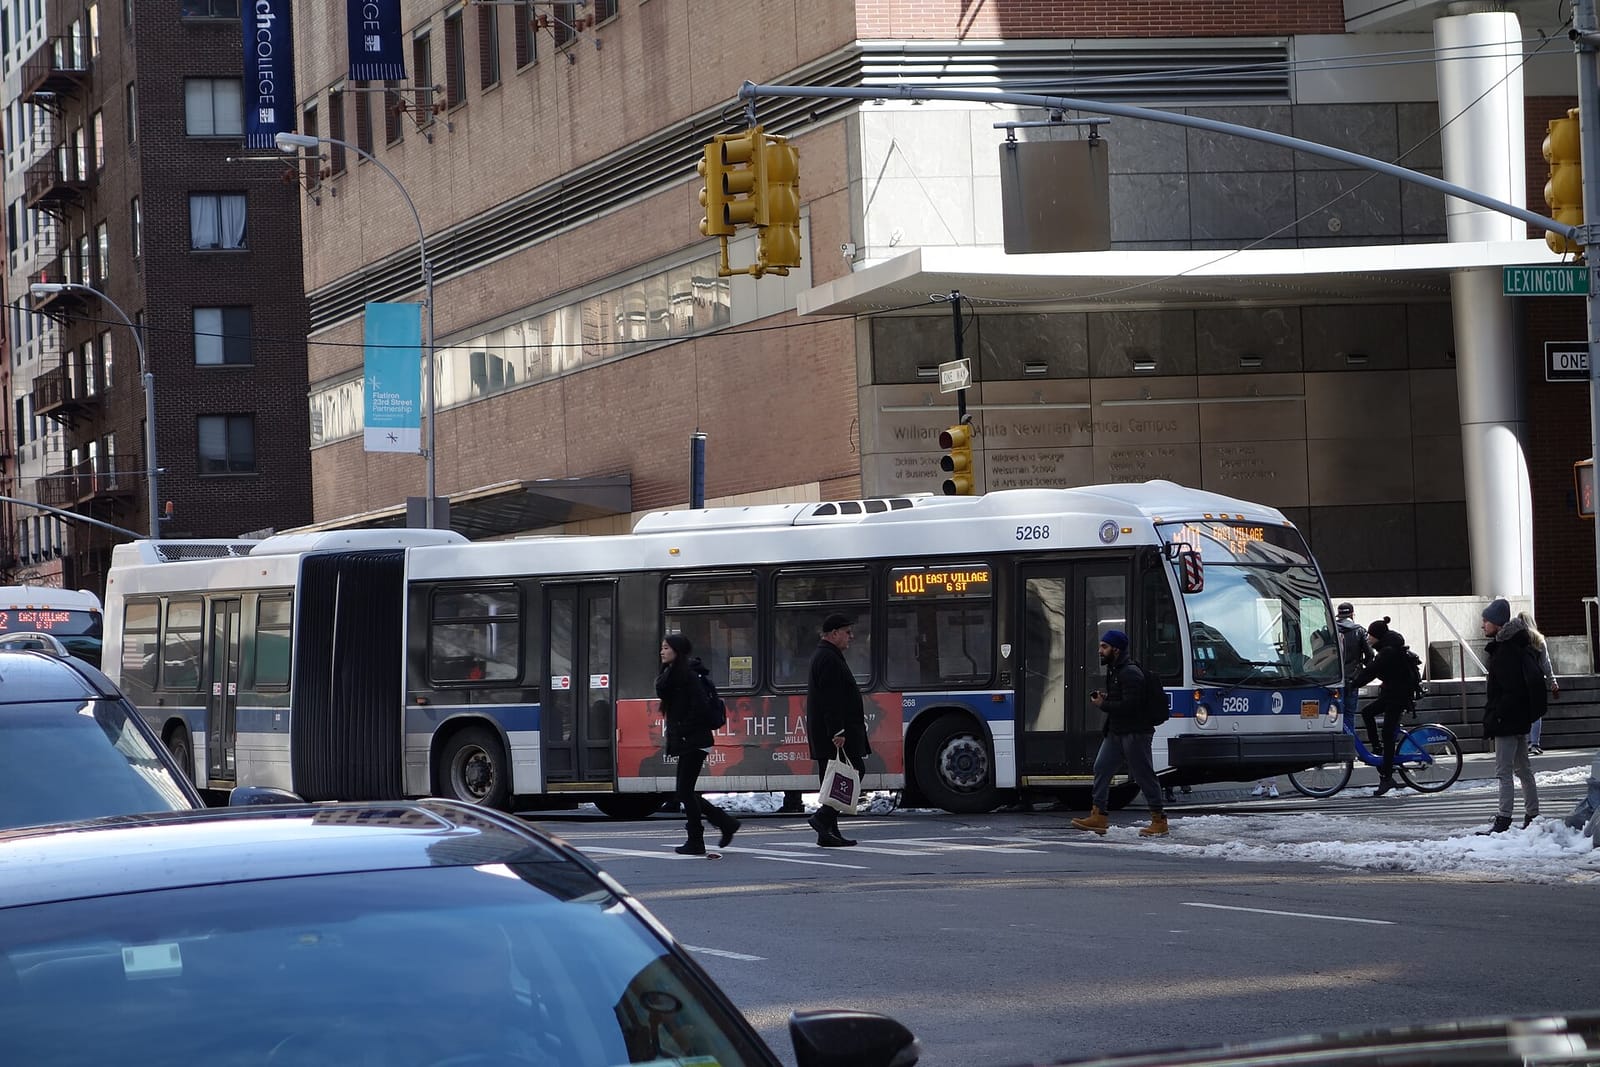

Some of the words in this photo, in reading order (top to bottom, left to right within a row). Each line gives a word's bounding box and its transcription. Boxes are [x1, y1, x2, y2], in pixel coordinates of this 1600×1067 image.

[1506, 270, 1574, 292] LEXINGTON
[1578, 269, 1587, 281] AV
[1560, 354, 1588, 369] ONE
[373, 406, 412, 414] Partnership
[1128, 417, 1177, 434] Campus
[1015, 525, 1050, 541] 5268
[1233, 527, 1264, 542] VILLAGE
[895, 574, 925, 594] M101
[926, 573, 947, 584] EAST
[950, 571, 989, 583] VILLAGE
[946, 582, 953, 592] 6
[955, 582, 968, 592] ST
[1222, 697, 1249, 713] 5268
[743, 716, 777, 736] THE
[772, 752, 788, 761] CBS
